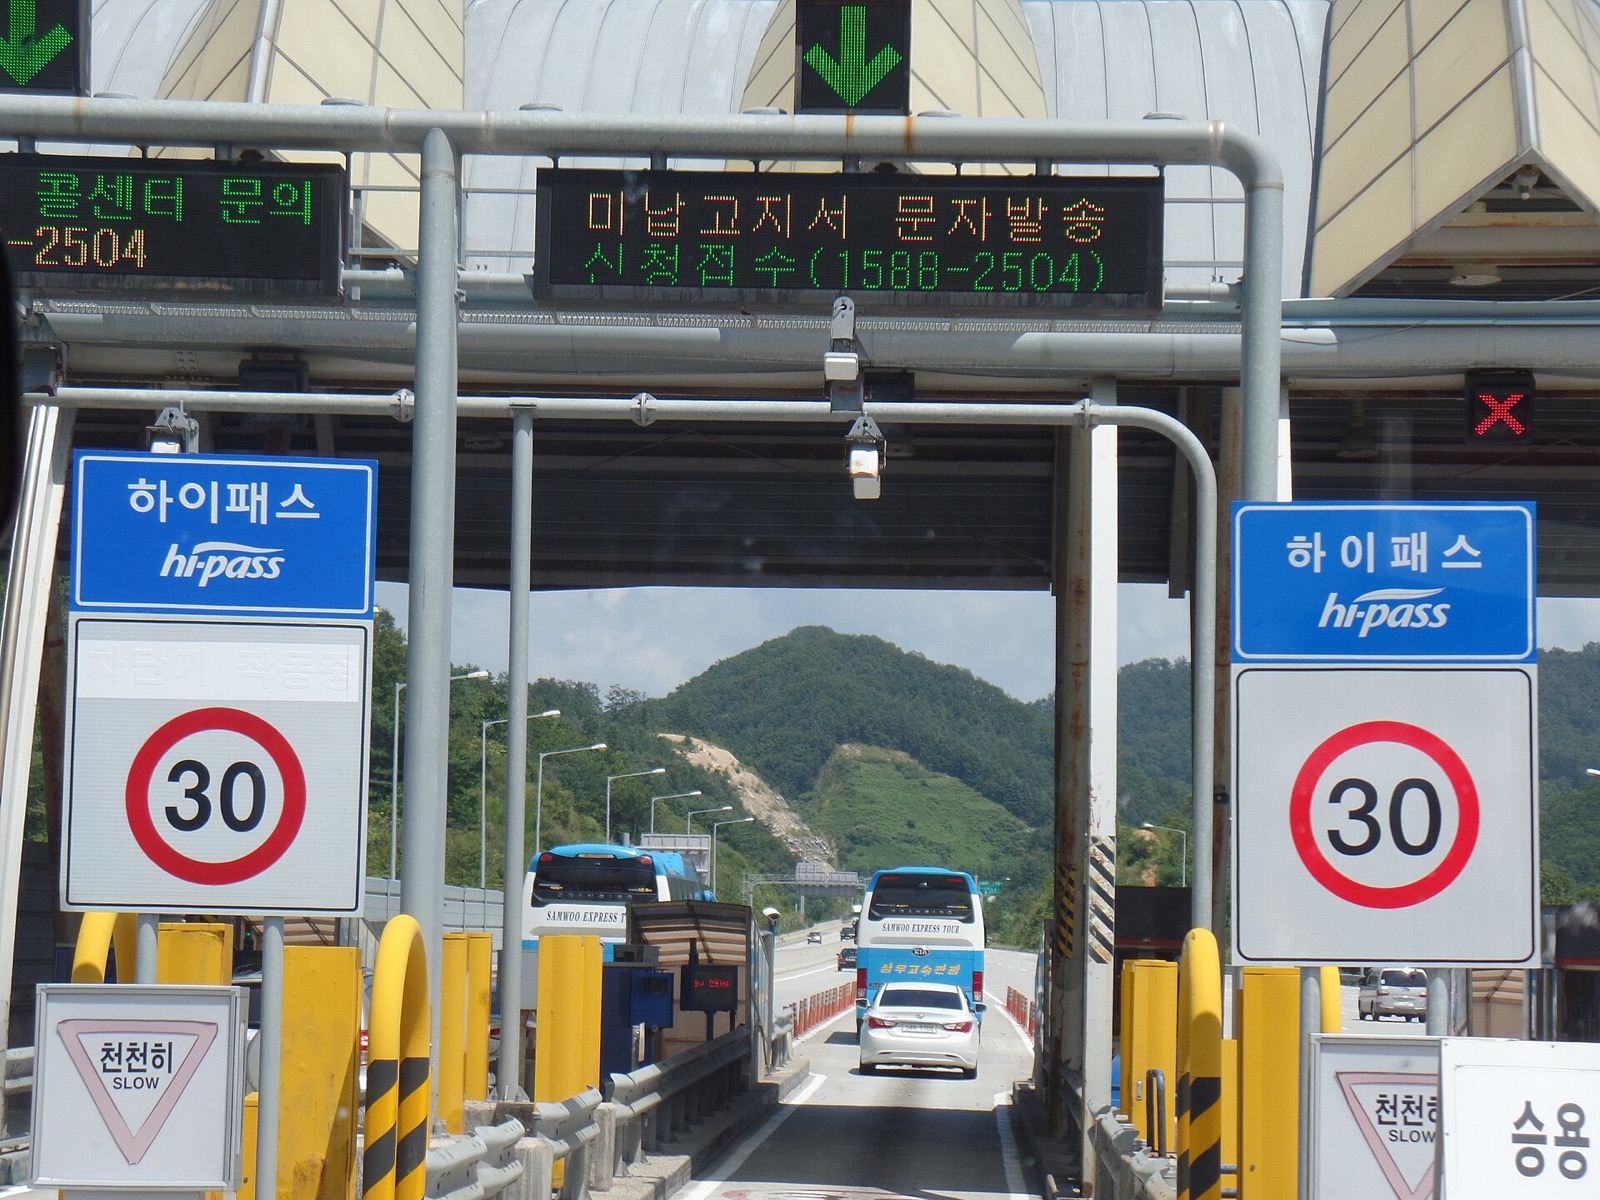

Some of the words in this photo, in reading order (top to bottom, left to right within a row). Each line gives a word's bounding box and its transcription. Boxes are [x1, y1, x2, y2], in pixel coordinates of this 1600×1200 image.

[37, 172, 185, 224] 콜센터
[219, 178, 312, 226] 문의
[588, 190, 847, 240] 미납고지서
[895, 195, 1106, 244] 문자발송
[127, 477, 321, 525] 하이패스
[159, 541, 286, 588] hi-pass
[1317, 587, 1451, 638] hi-pass
[164, 759, 267, 833] 30
[1327, 777, 1442, 857] 30
[546, 910, 580, 923] SAMWOO
[582, 911, 618, 923] EXPRESS
[881, 922, 910, 933] SAMWOO
[911, 924, 940, 934] EXPRESS
[942, 925, 960, 934] TOUR
[100, 1041, 173, 1074] 천천히
[112, 1076, 159, 1090] SLOW
[1388, 1129, 1436, 1143] SLOW
[1511, 1100, 1591, 1180] 승용
